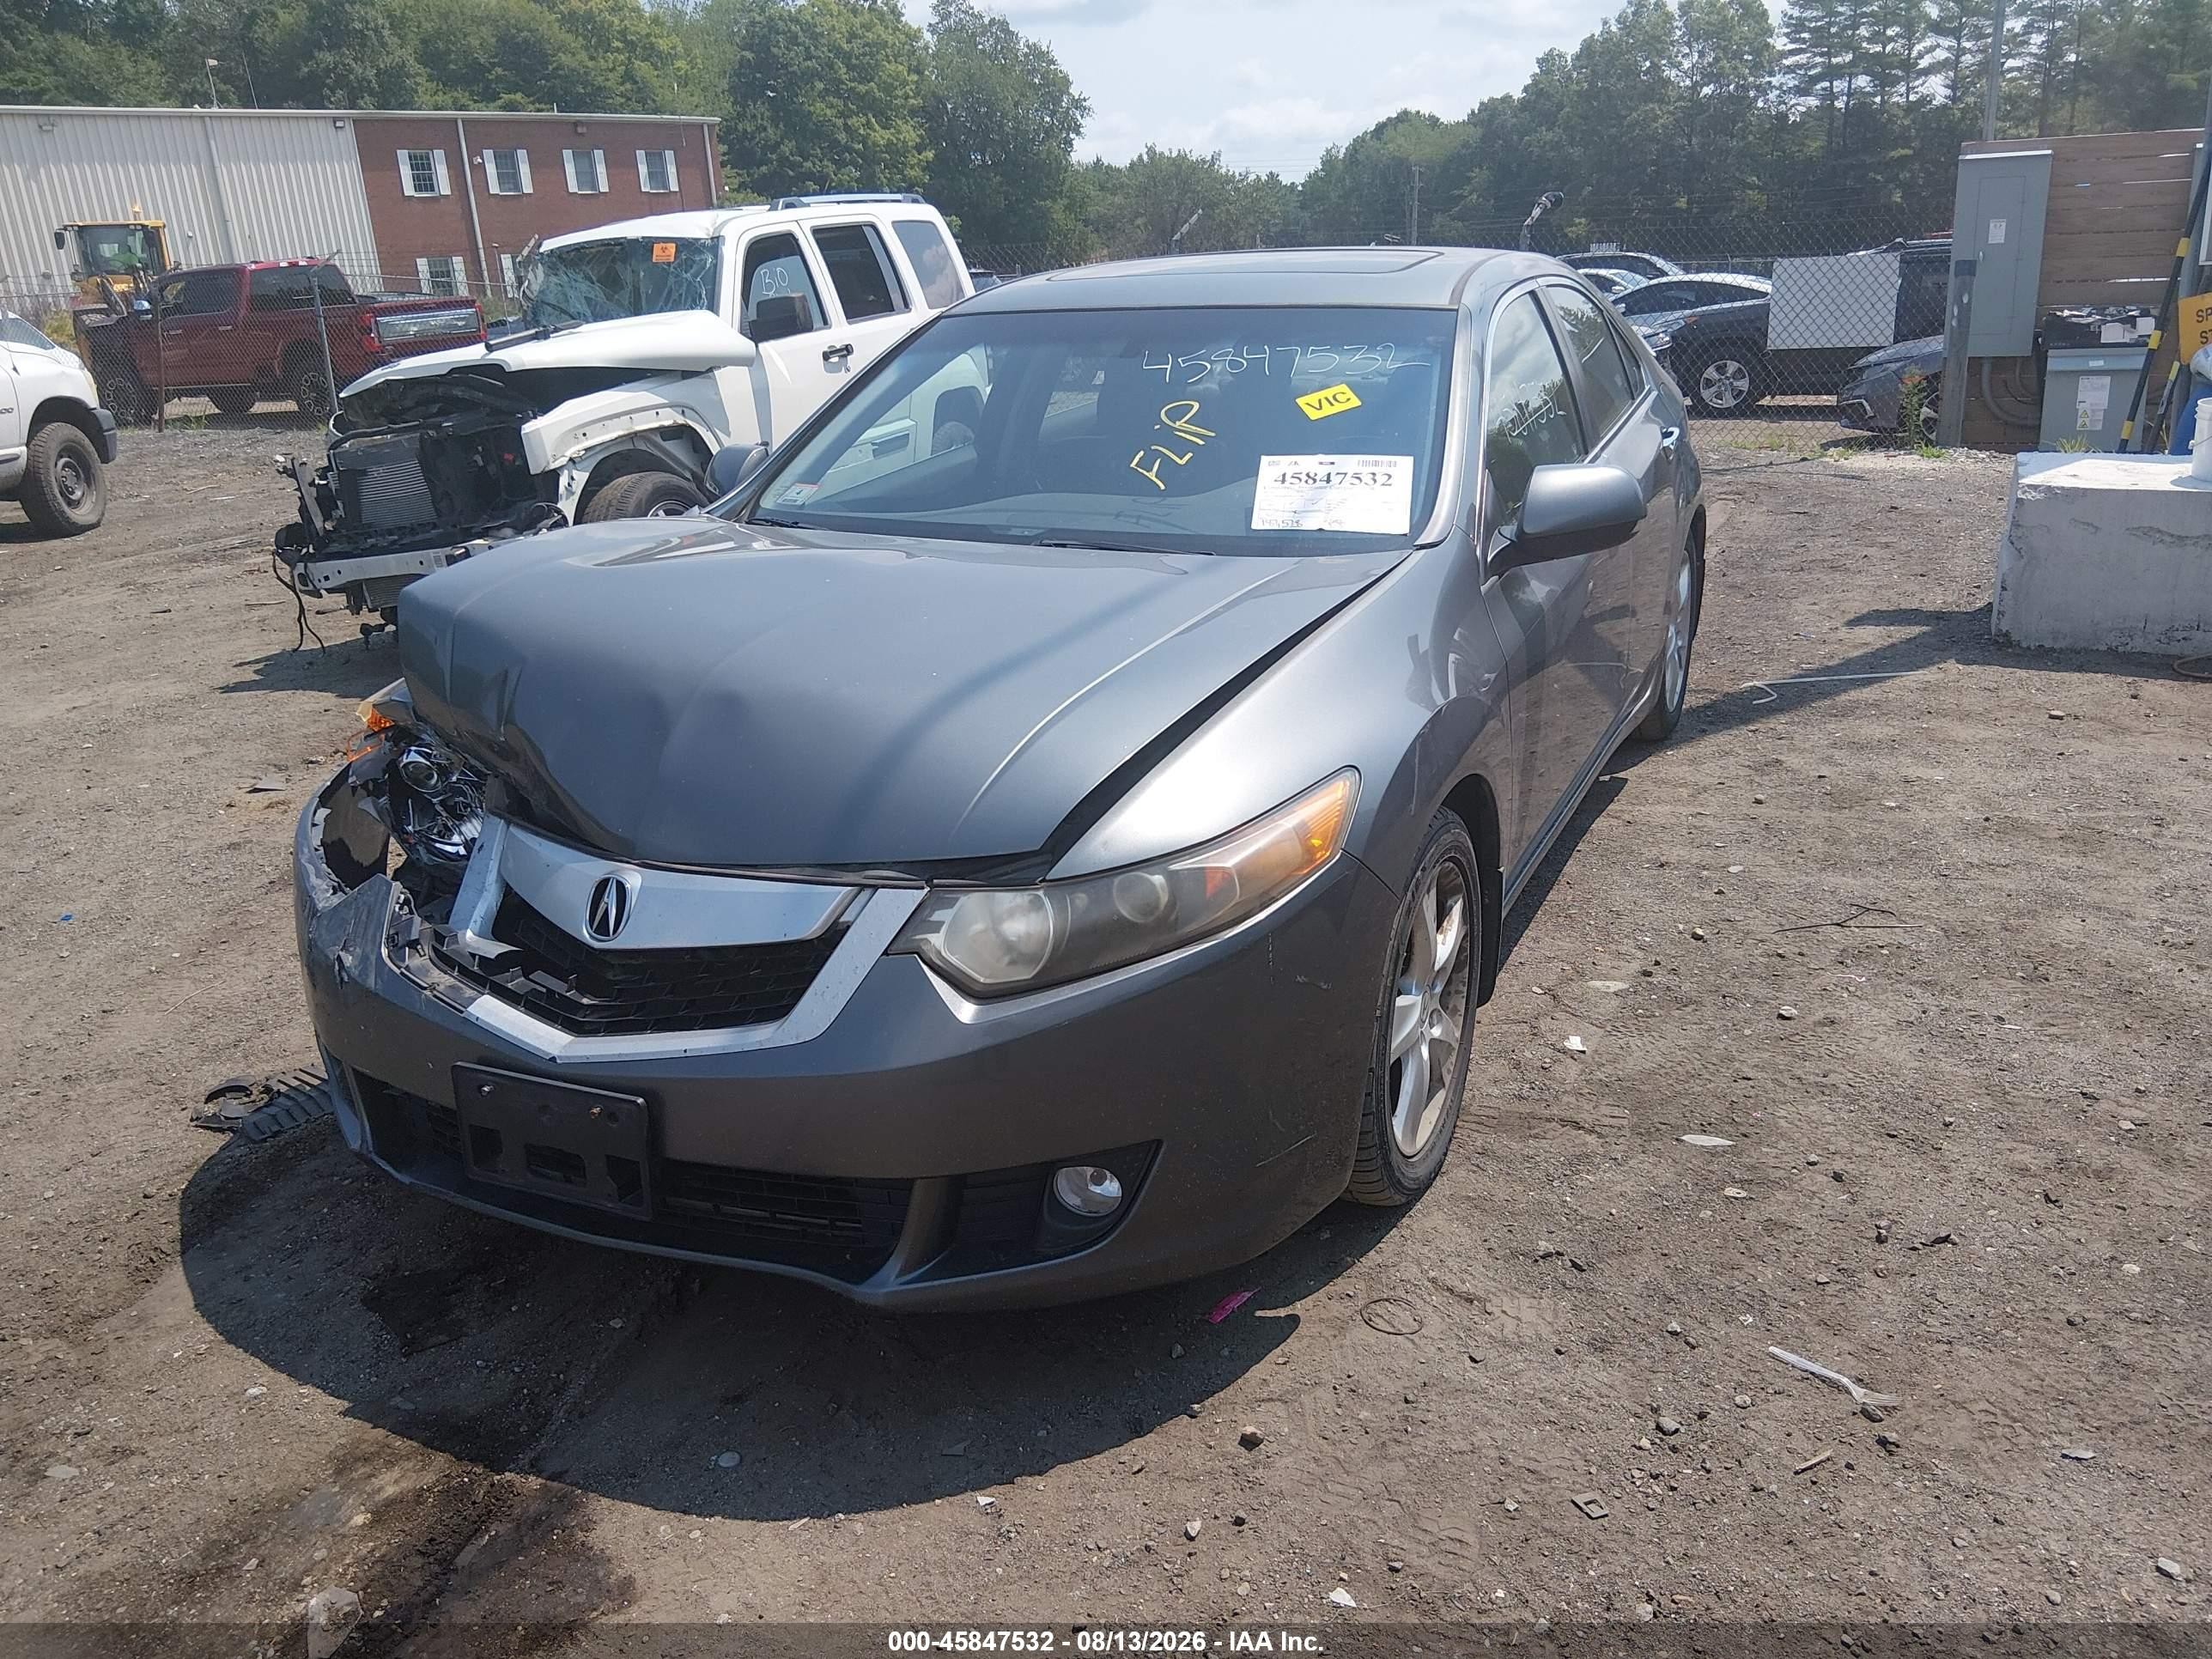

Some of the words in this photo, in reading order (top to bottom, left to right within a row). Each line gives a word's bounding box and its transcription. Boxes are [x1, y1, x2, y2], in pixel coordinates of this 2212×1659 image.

[1142, 343, 1431, 383] 45847532
[1304, 392, 1351, 411] VIC
[1273, 471, 1394, 487] 45847532
